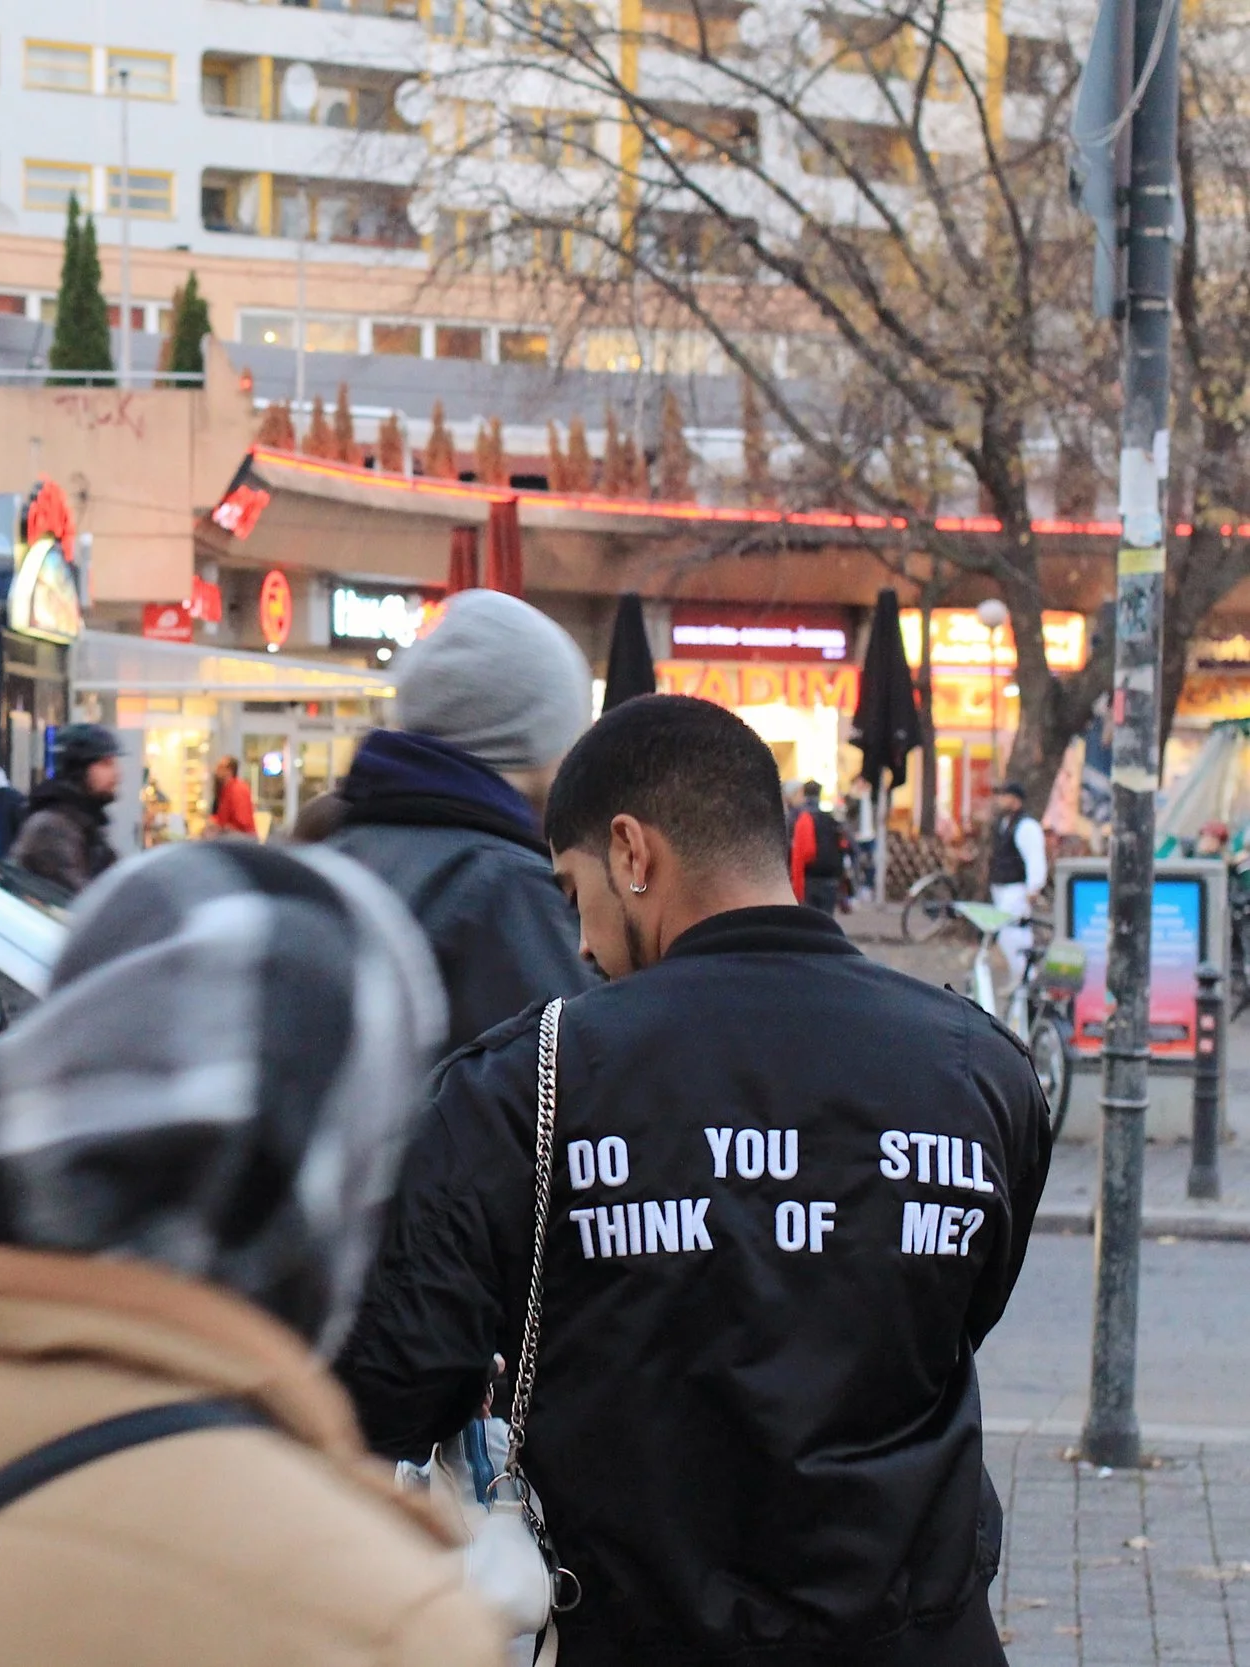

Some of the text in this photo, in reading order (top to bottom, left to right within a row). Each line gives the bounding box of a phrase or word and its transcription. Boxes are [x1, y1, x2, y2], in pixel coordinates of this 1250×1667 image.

[656, 664, 859, 708] TADIM
[567, 1127, 994, 1193] DO YOU STILL
[569, 1197, 985, 1260] THINK OF ME?
